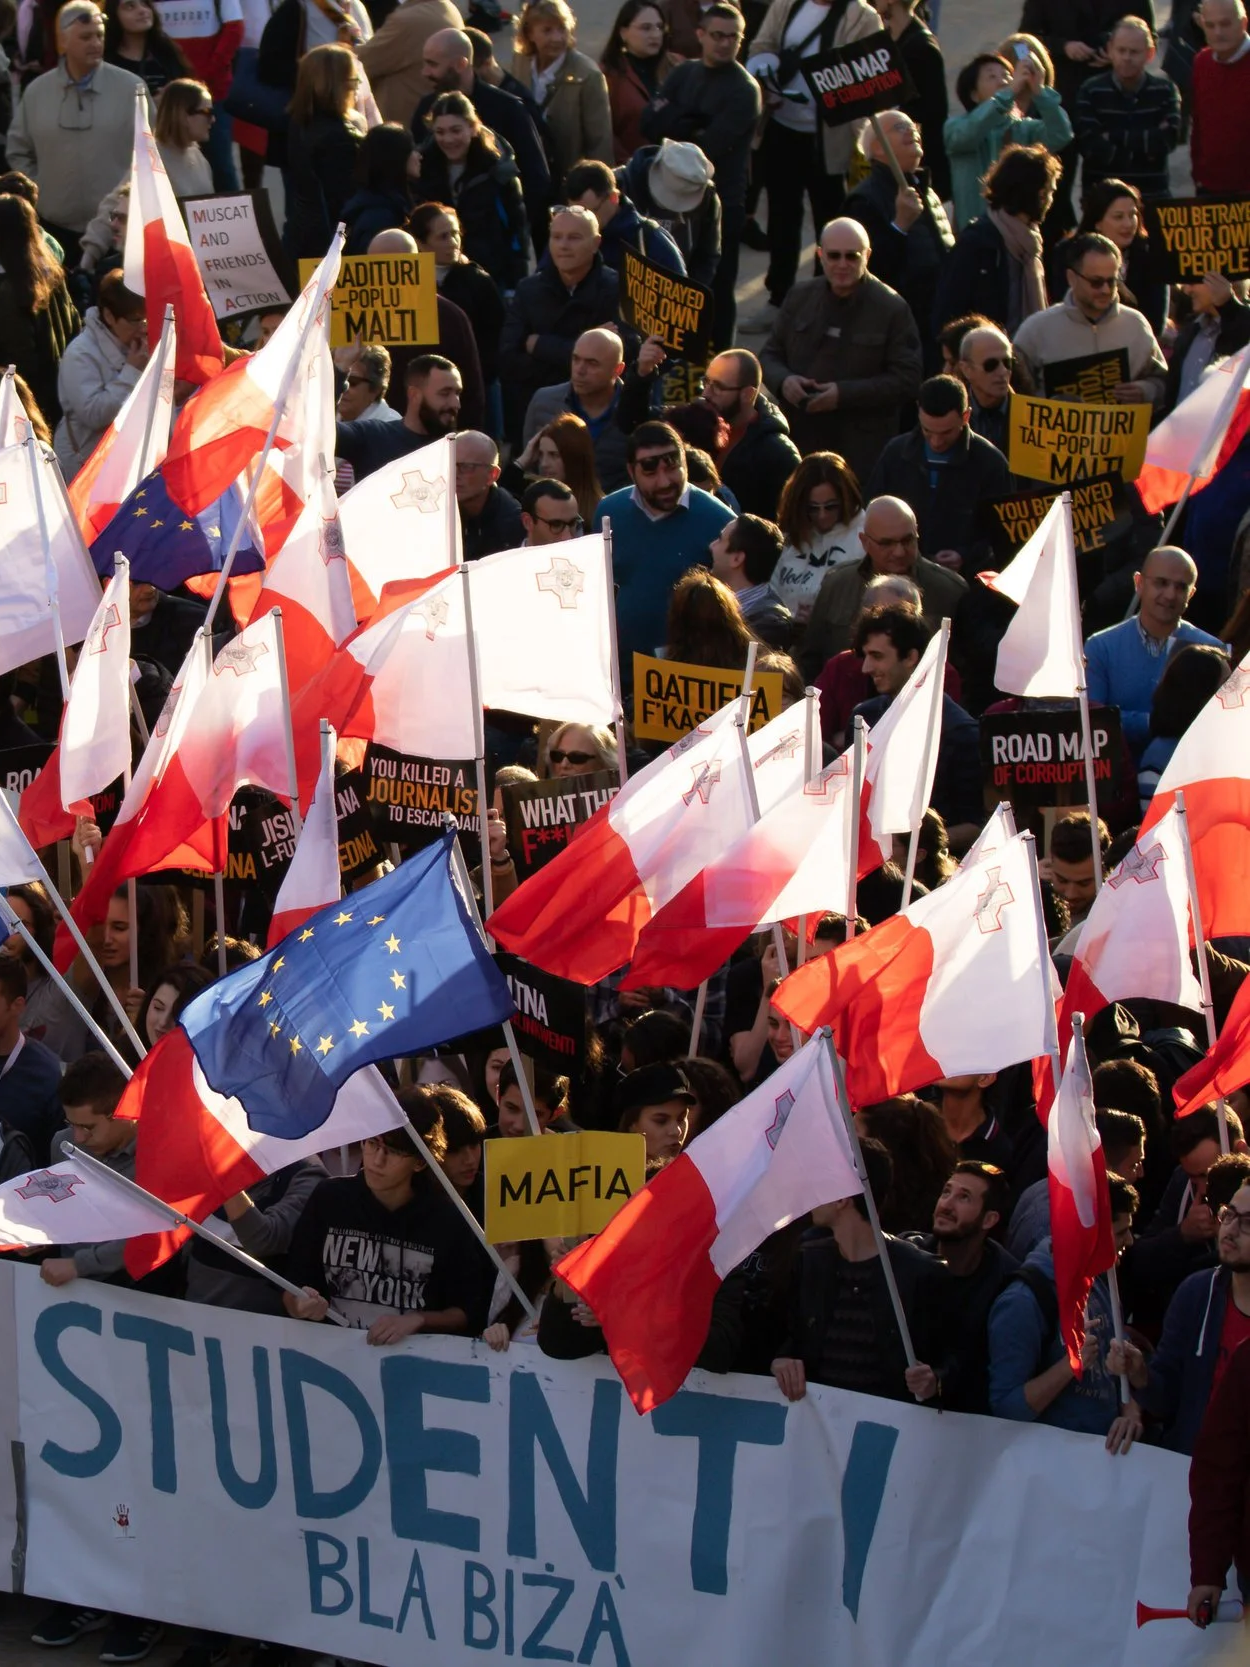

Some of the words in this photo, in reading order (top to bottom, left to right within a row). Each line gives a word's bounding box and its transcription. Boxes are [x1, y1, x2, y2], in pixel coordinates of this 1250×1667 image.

[812, 63, 854, 93] ROAD
[851, 48, 891, 81] MAP
[193, 205, 248, 224] MUSCAT
[1156, 207, 1188, 226] YOU
[200, 232, 230, 248] AND
[1162, 226, 1214, 252] YOUR
[205, 253, 266, 271] FRIENDS
[1180, 248, 1249, 276] PEOPLE
[214, 279, 232, 289] IN
[625, 252, 644, 280] YOU
[645, 266, 704, 310] BETRAYED
[225, 292, 281, 311] ACTION
[626, 273, 657, 317] YOUR
[660, 298, 698, 332] OWN
[345, 310, 417, 342] MALTI
[634, 304, 685, 351] PEOPLE
[1027, 402, 1135, 434] TRADITURI
[1019, 426, 1111, 456] TAL-POPLU
[993, 501, 1029, 522] YOU
[992, 732, 1051, 765] ROAD
[1058, 729, 1108, 762] MAP
[371, 757, 397, 778] YOU
[401, 762, 451, 786] KILLED
[454, 769, 464, 788] A
[994, 764, 1012, 785] OF
[1016, 759, 1111, 785] CORRUPTON
[366, 777, 480, 815] JOURNALIST
[519, 794, 576, 828] WHAT
[388, 805, 403, 822] TO
[406, 808, 445, 828] ESCAP
[500, 1165, 632, 1207] MAFIA
[322, 1234, 381, 1273] NEW
[363, 1271, 426, 1309] YORK
[304, 1530, 436, 1640] BLA
